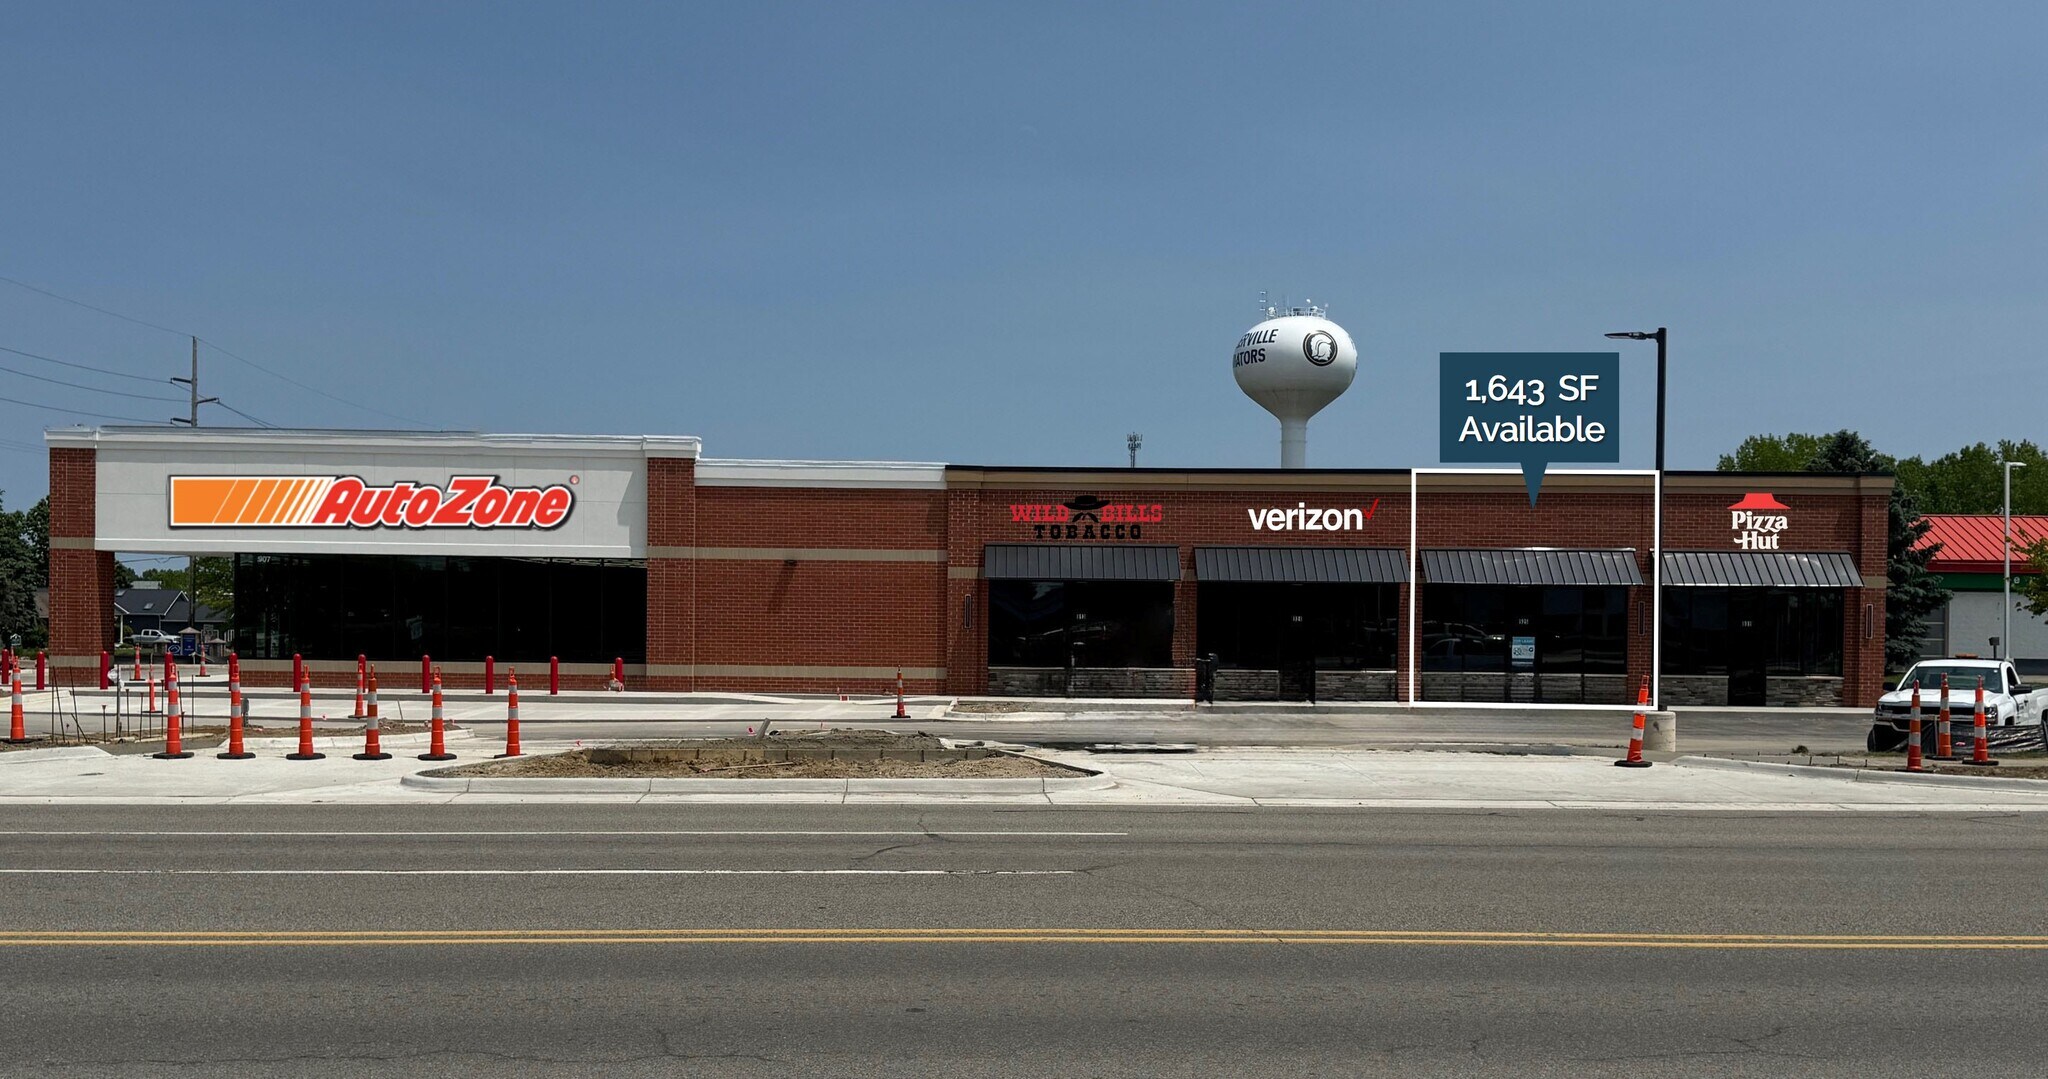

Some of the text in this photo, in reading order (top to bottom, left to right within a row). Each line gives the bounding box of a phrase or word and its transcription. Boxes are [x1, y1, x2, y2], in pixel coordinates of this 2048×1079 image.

[311, 475, 573, 528] AutoZone
[1009, 504, 1163, 523] WILD BILLS
[1248, 502, 1363, 531] verizon
[1731, 511, 1788, 533] Pizza
[1034, 524, 1141, 539] TOBACCO
[1733, 531, 1780, 550] Hut
